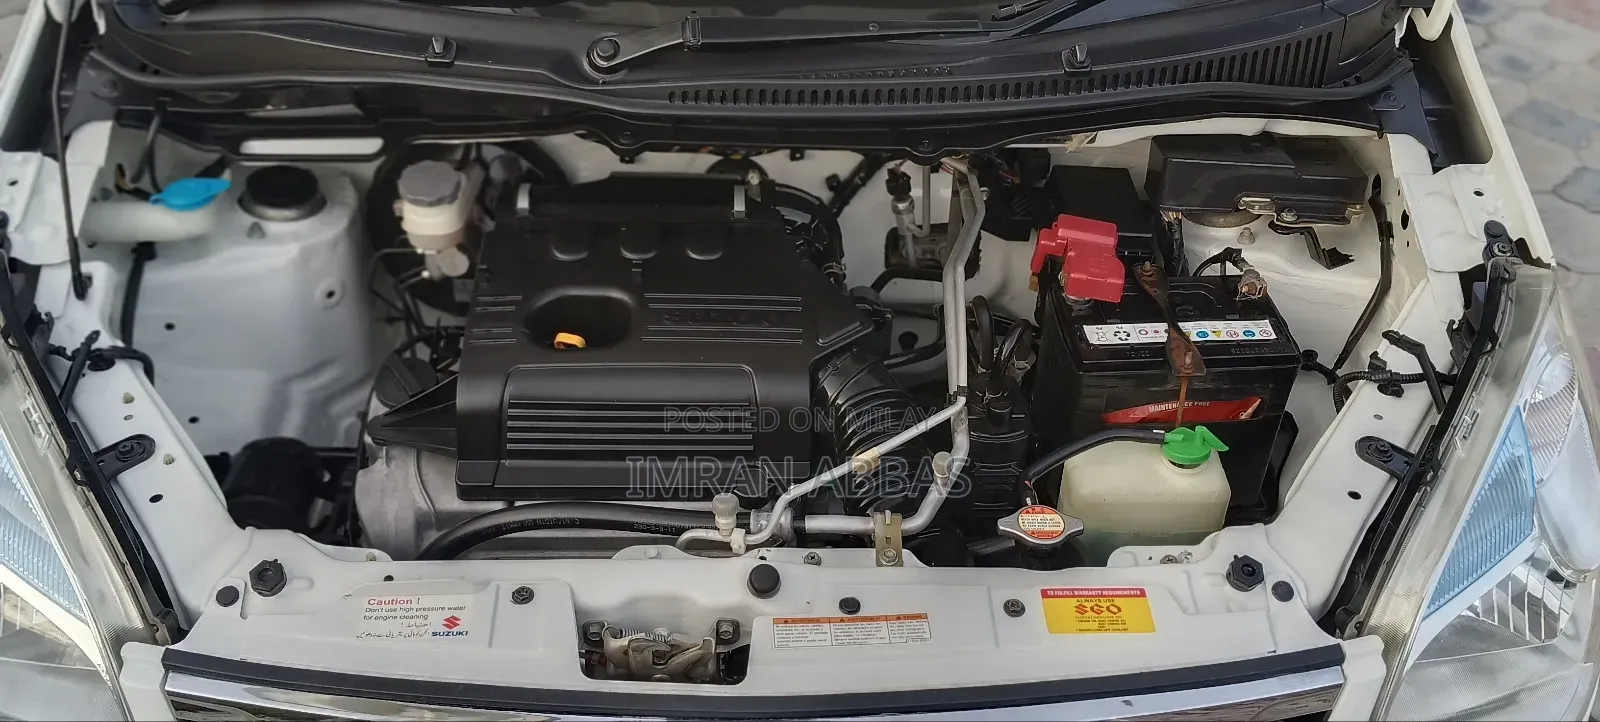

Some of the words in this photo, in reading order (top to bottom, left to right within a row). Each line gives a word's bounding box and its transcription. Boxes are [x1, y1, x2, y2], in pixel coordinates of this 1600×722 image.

[1148, 401, 1192, 413] MAINTENACE
[367, 597, 413, 606] Caution
[416, 597, 421, 605] !
[399, 606, 414, 614] high
[415, 605, 446, 613] pressure
[1074, 603, 1122, 615] SGO
[374, 614, 398, 622] engine
[399, 613, 429, 621] cleaning
